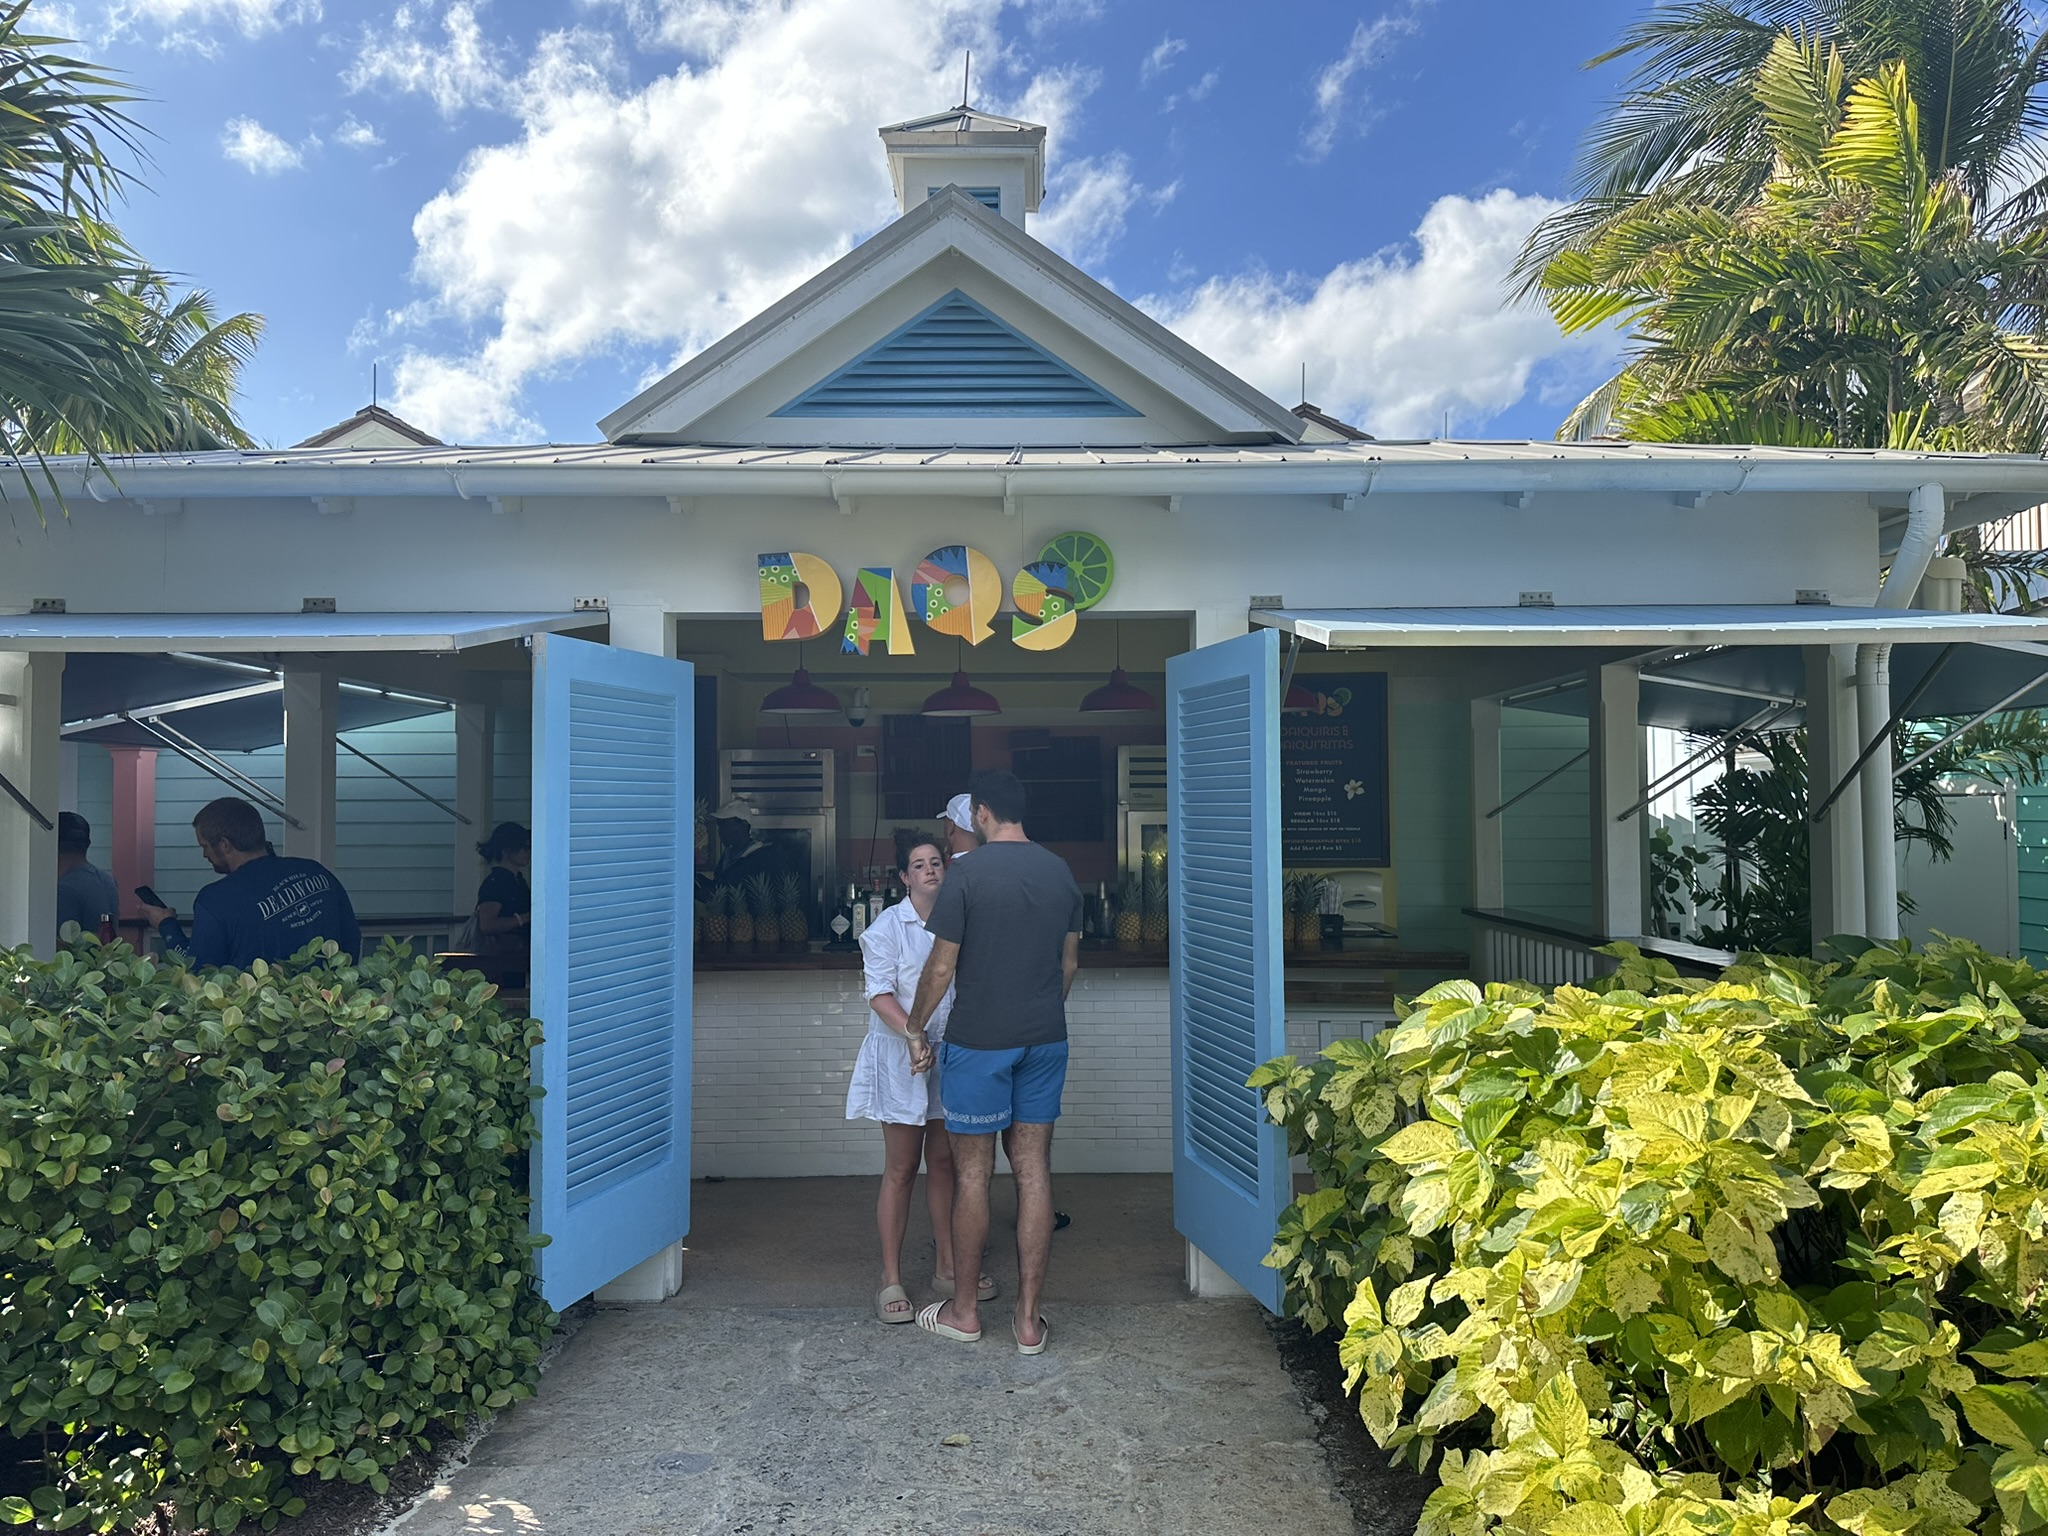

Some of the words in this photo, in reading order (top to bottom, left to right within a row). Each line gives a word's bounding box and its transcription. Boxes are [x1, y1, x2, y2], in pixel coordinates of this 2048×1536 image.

[757, 545, 1078, 656] DAQS
[1342, 725, 1349, 736] &
[1282, 739, 1354, 751] AIQUI'RITAS
[1295, 768, 1333, 776] Strawberry
[1303, 786, 1327, 794] Mango
[1298, 795, 1332, 803] Pineapple
[272, 878, 289, 892] BLACK
[288, 873, 307, 881] HILLS
[256, 874, 330, 919] DEADWOOD
[290, 920, 306, 929] SOUTH
[970, 1113, 998, 1124] BOSS
